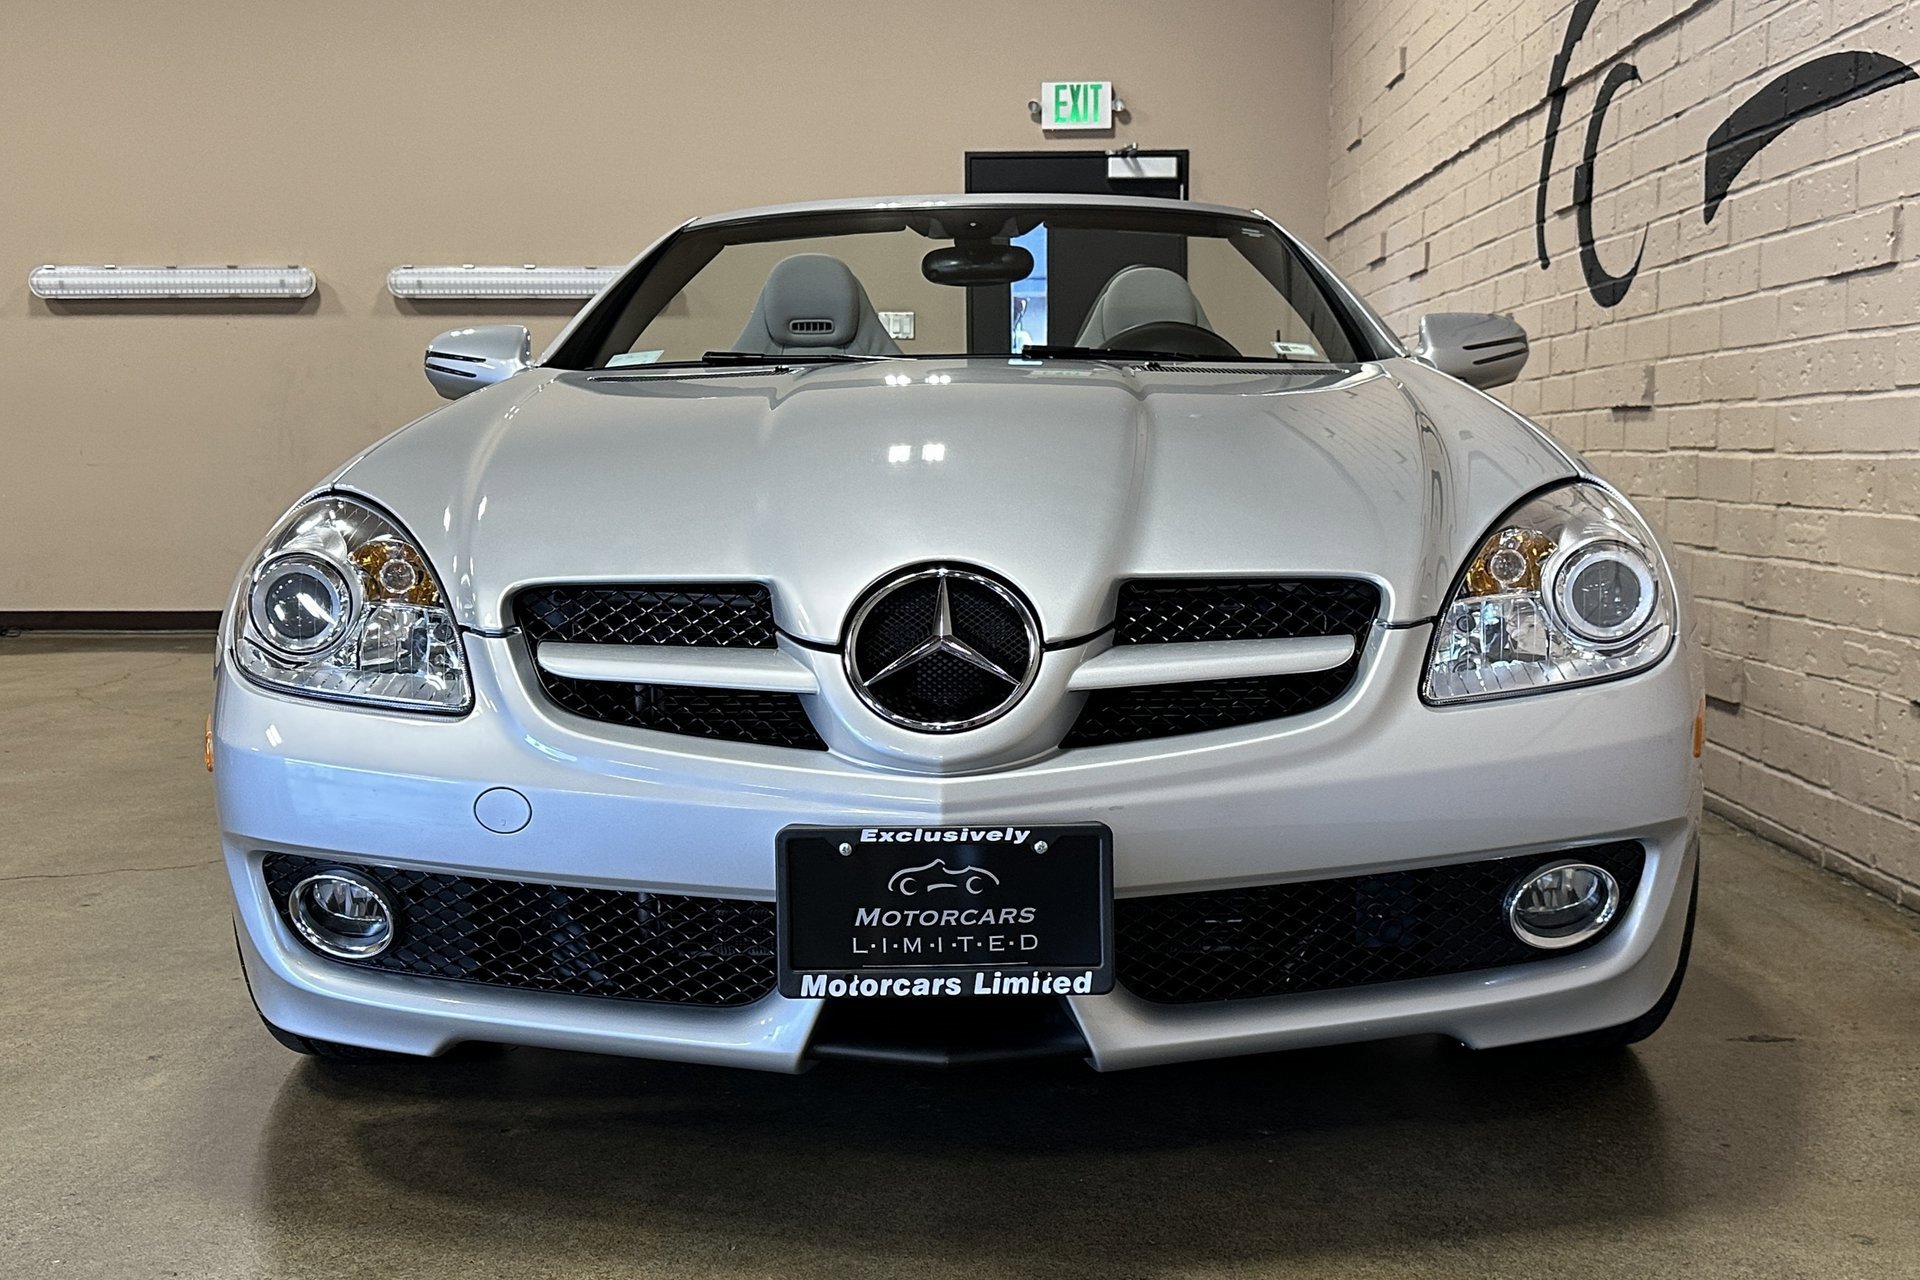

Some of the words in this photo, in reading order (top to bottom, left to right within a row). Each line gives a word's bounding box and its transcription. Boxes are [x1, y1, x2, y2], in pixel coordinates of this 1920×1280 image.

[1054, 84, 1103, 123] EXIT
[860, 828, 1031, 844] Exclusively
[854, 907, 1037, 926] MOTORCARS
[800, 974, 962, 997] Motorcars
[974, 971, 1093, 995] Limited
